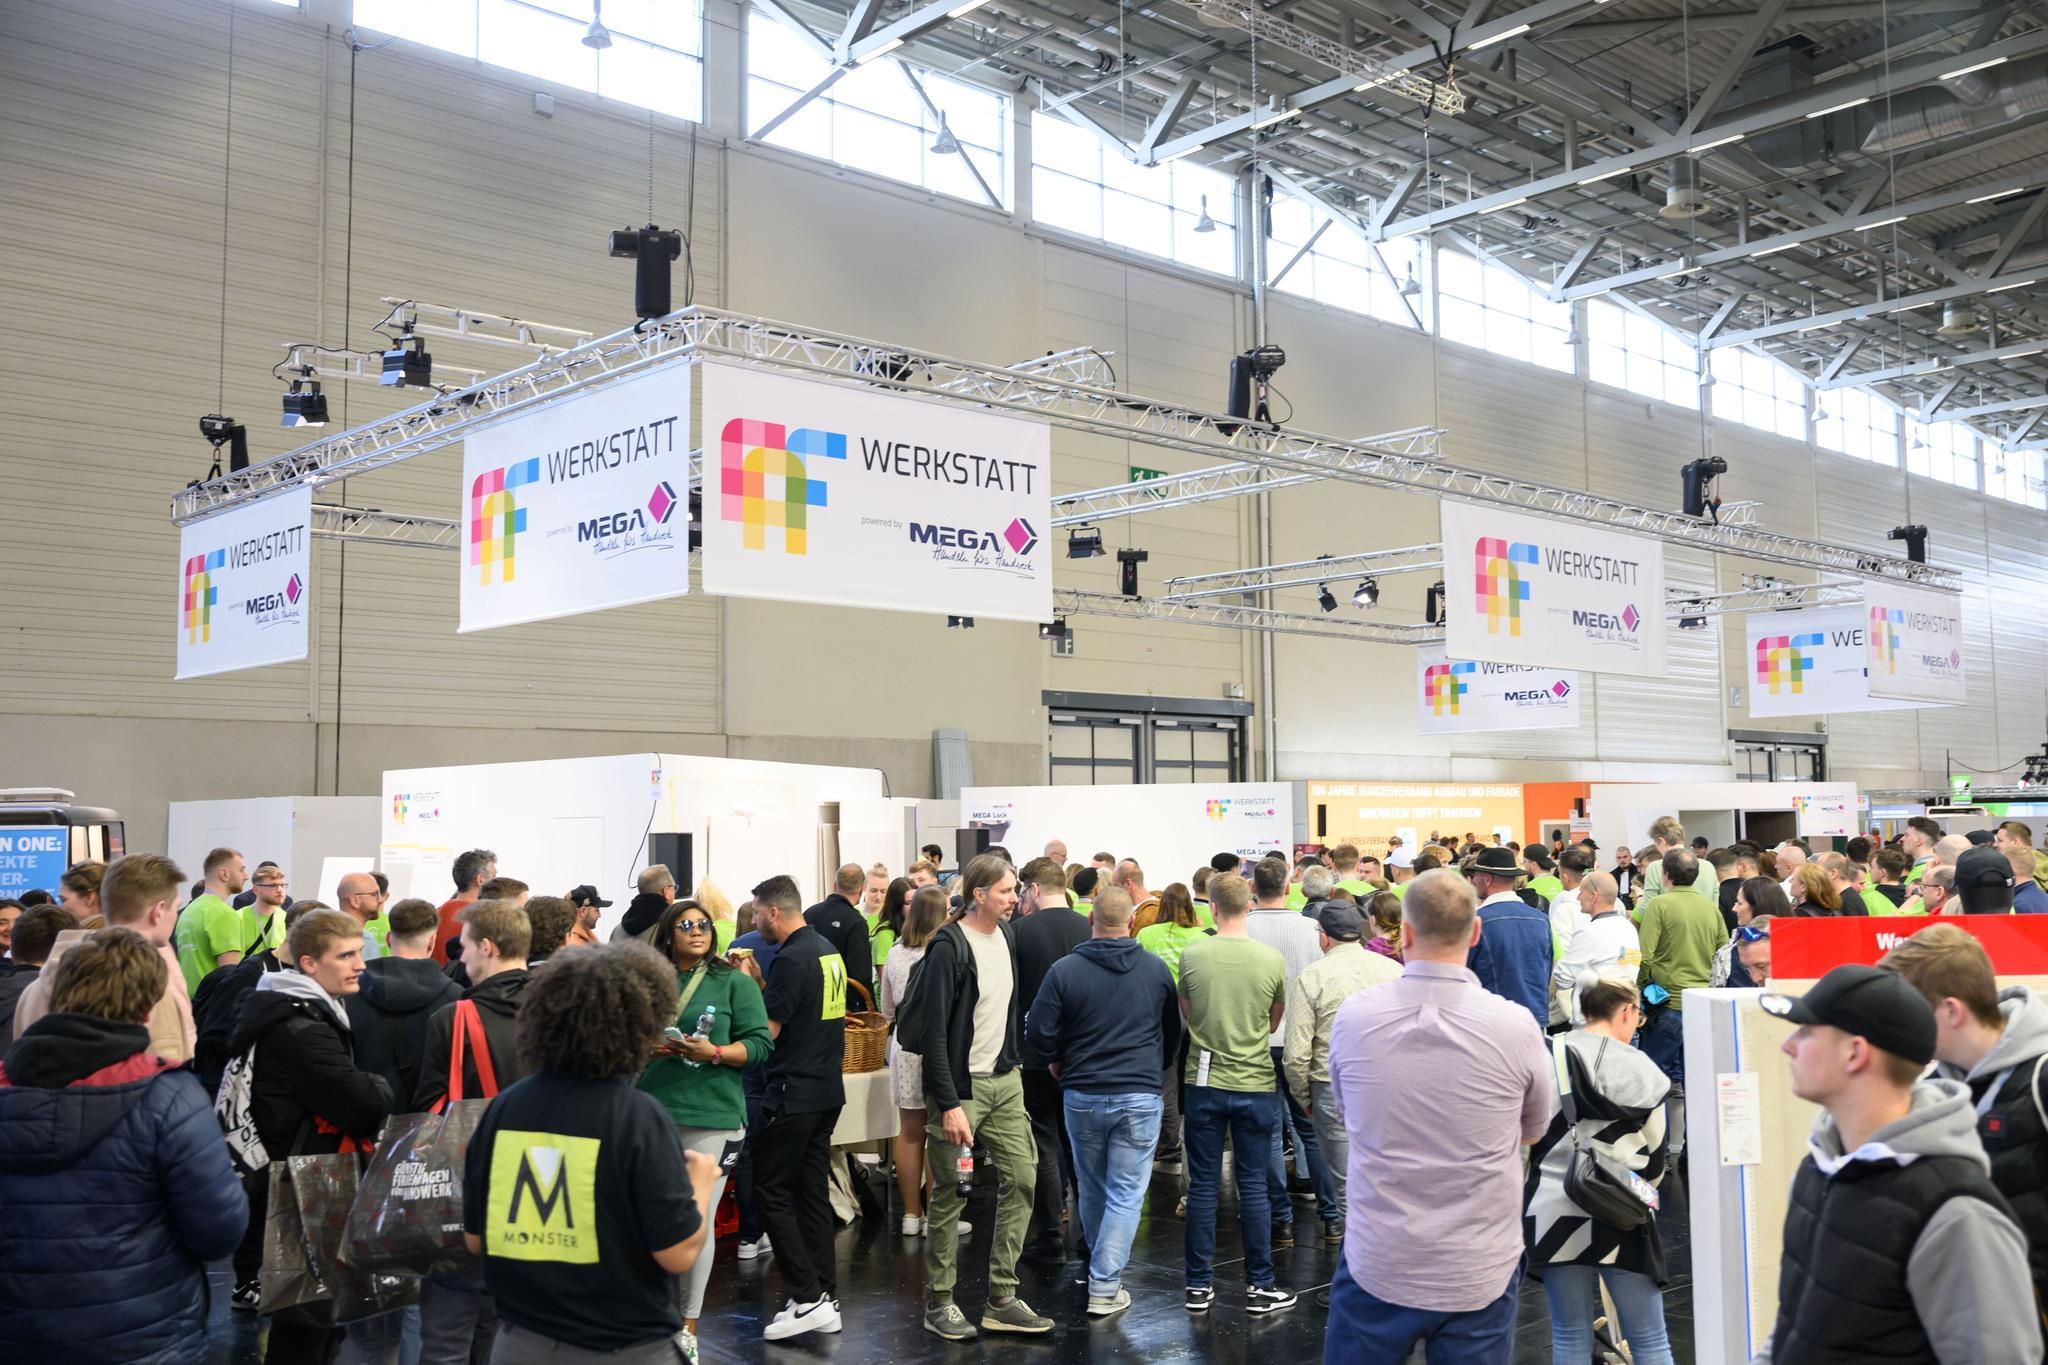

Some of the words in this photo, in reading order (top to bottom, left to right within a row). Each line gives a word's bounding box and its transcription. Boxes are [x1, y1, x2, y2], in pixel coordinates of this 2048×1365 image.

[547, 416, 678, 484] WERKSTATT
[861, 437, 1037, 495] WERKSTATT
[578, 508, 645, 542] MEGA
[861, 517, 892, 527] powered
[894, 521, 903, 529] by
[230, 525, 304, 569] WERKSTATT
[909, 522, 1001, 552] MEGA
[1545, 547, 1639, 586] WERKSTATT
[246, 592, 285, 615] MEGA
[1572, 610, 1622, 631] MEGA
[1505, 689, 1551, 701] MEGA
[0, 837, 13, 851] N
[17, 836, 62, 851] ONE:
[0, 855, 38, 868] EKTE
[0, 872, 29, 886] ER-
[1876, 932, 1908, 950] Wa
[507, 1149, 574, 1227] M
[503, 1232, 578, 1249] MONSTER
